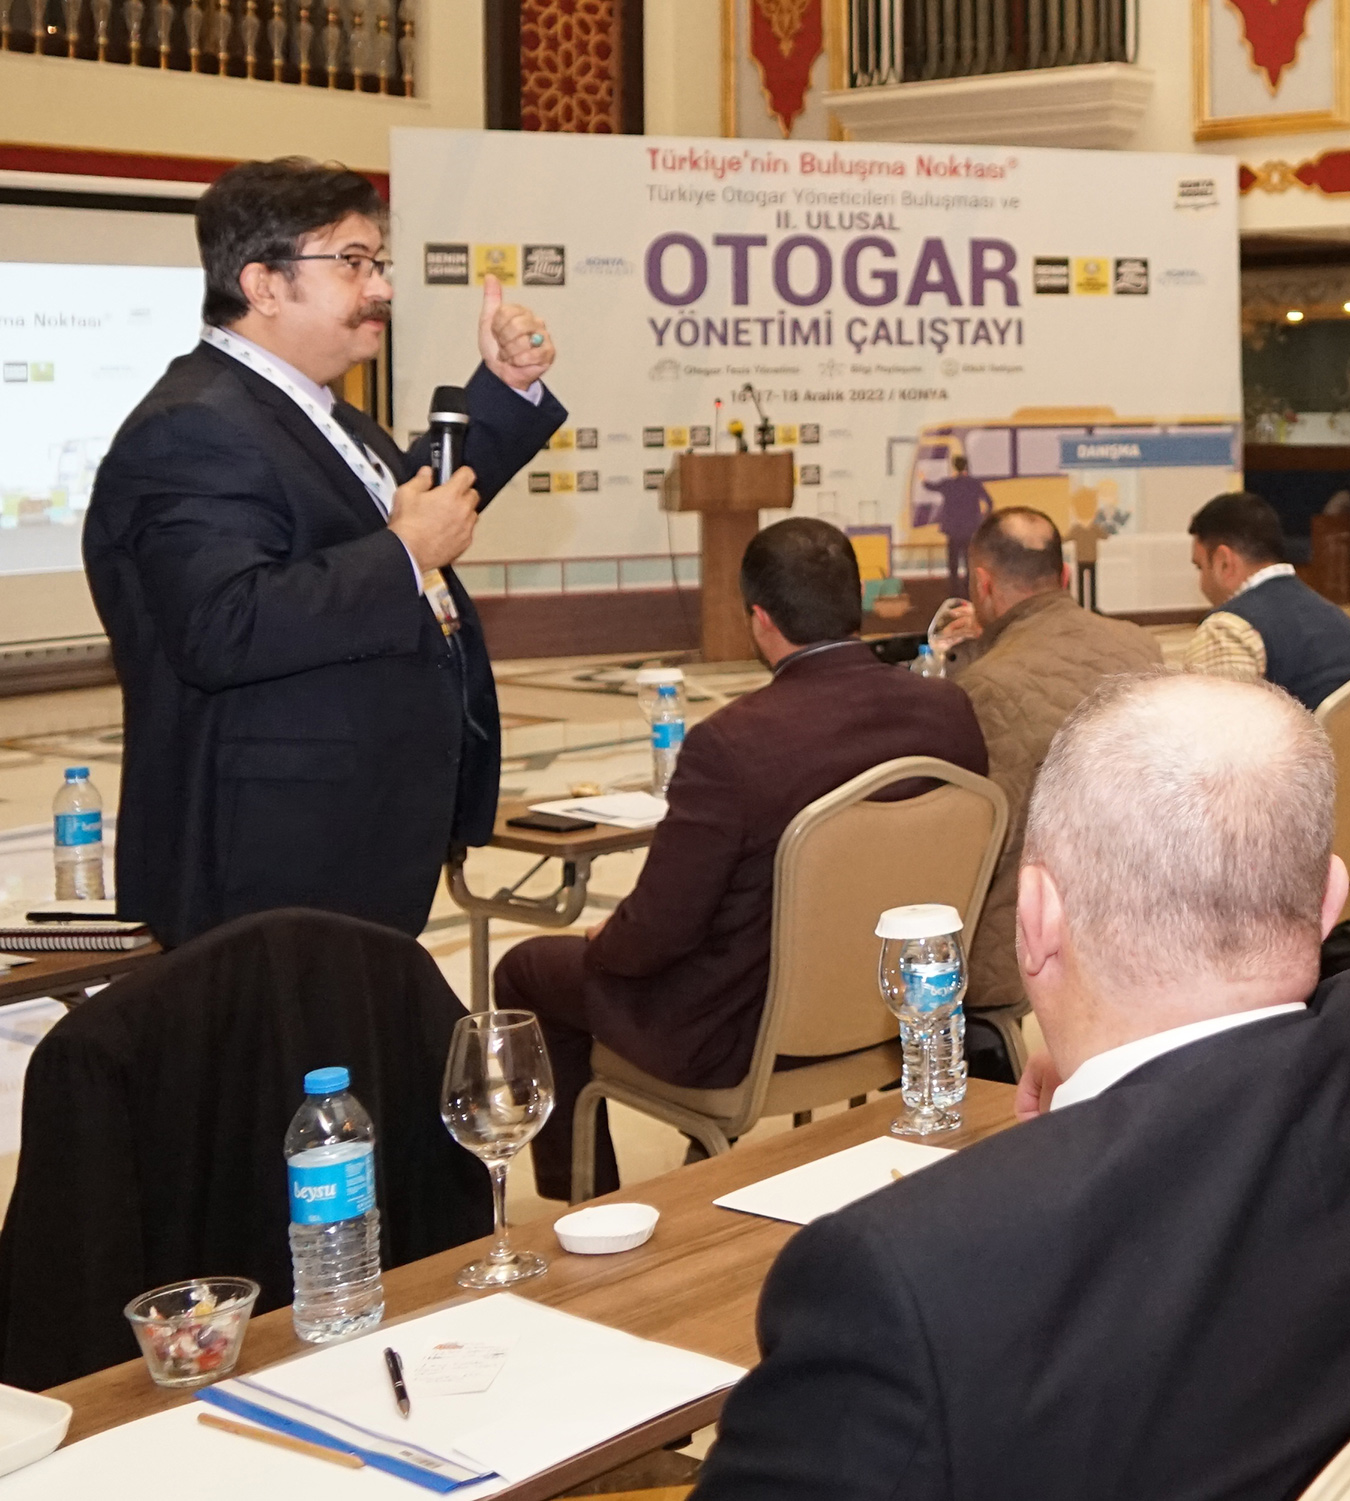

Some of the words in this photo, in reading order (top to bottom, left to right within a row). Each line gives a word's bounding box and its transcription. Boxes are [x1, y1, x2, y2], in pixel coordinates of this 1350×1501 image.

[647, 147, 788, 179] Türkiye'nin
[800, 151, 906, 181] Buluşma
[647, 184, 716, 205] Türkiye
[722, 186, 785, 207] Otogar
[794, 187, 895, 206] Yöneticileri
[1001, 196, 1020, 208] ve
[776, 209, 797, 229] II.
[806, 211, 900, 231] ULUSAL
[646, 232, 1020, 306] OTOGAR
[647, 310, 833, 347] YÖNETİMİ
[846, 317, 1024, 354] ÇALIŞTAYI
[849, 388, 884, 401] 2022
[898, 387, 949, 400] KONYA
